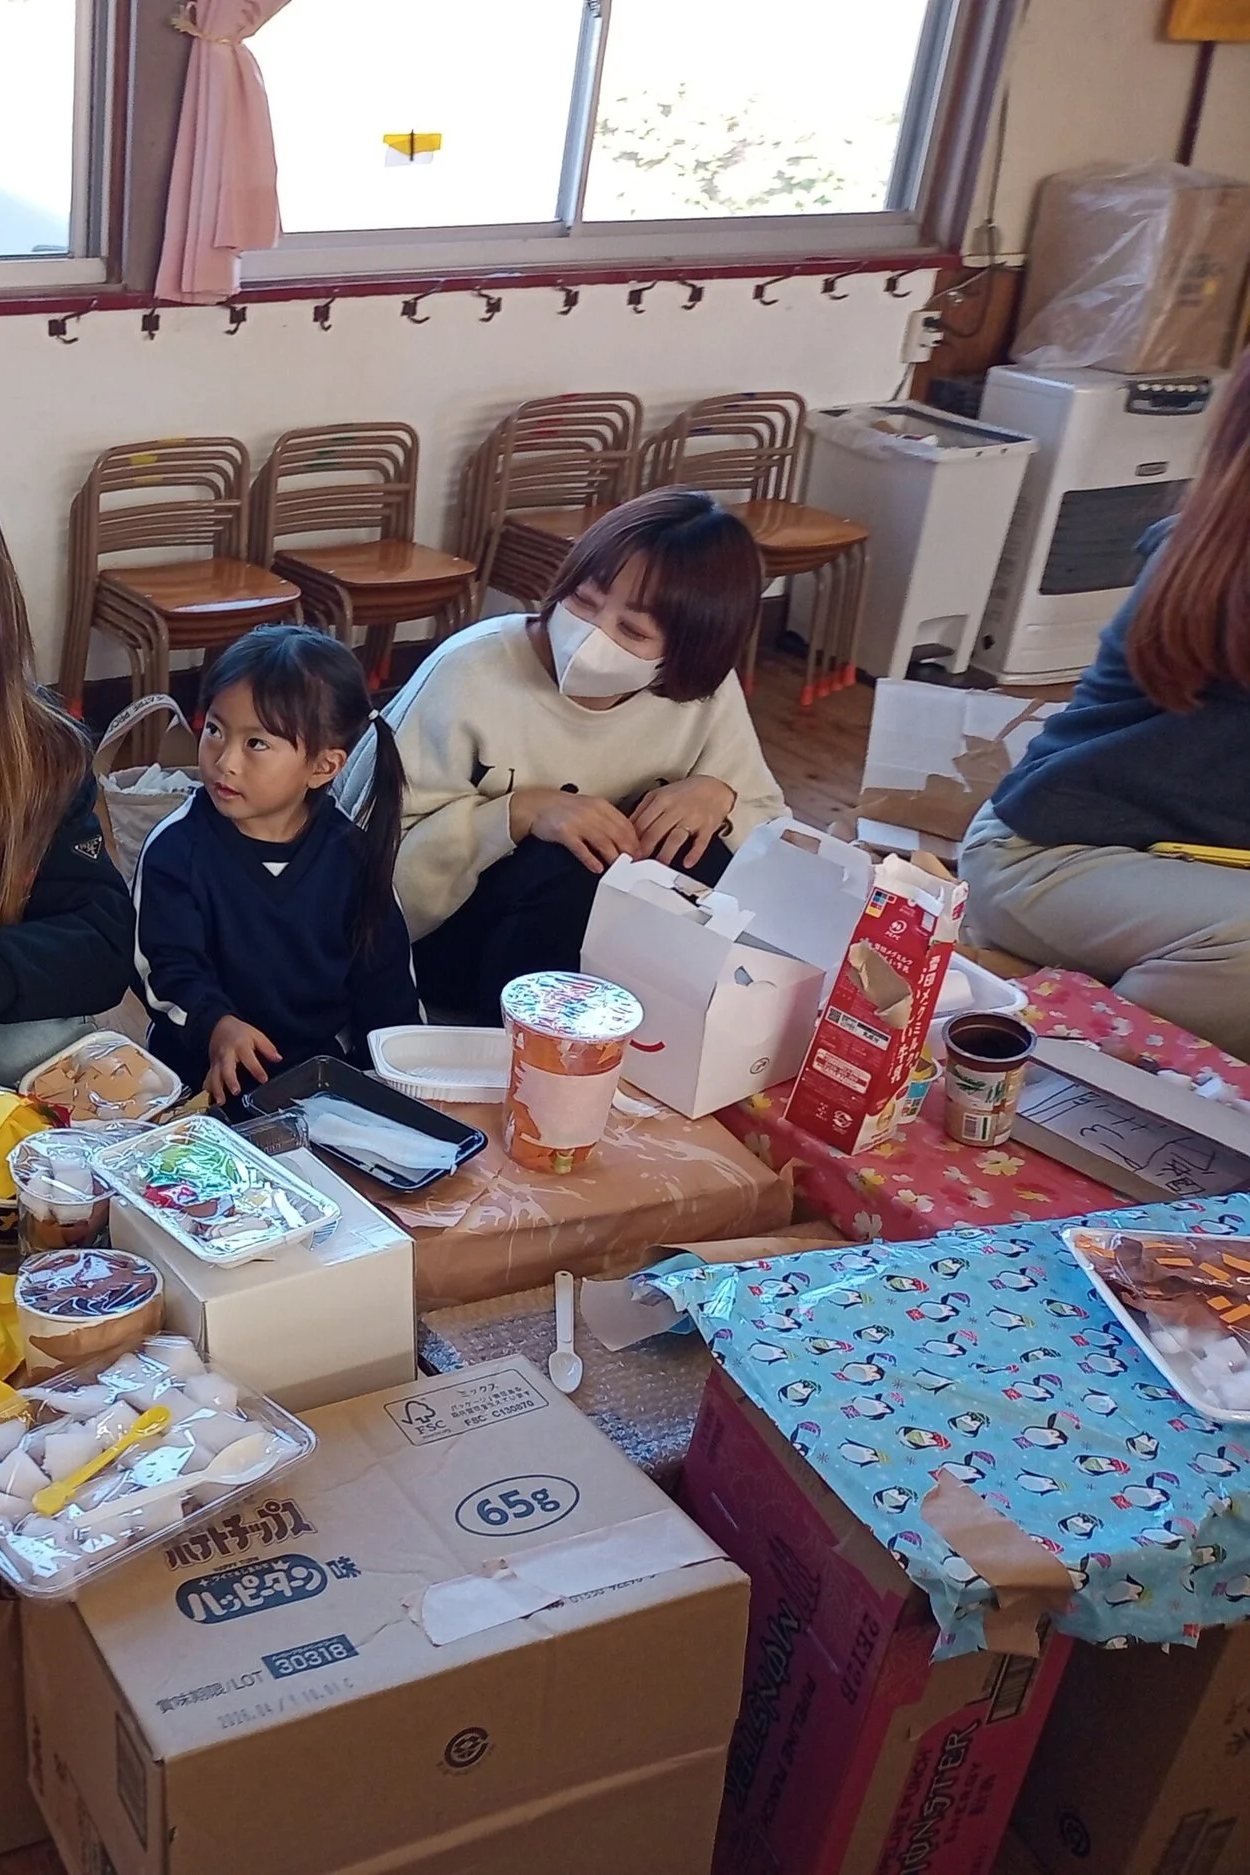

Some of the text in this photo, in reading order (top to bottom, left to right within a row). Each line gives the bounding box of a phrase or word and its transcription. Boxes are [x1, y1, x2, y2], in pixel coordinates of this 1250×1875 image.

[456, 1382, 499, 1398] ミックス
[415, 1419, 447, 1436] FSC
[475, 1487, 561, 1527] 65g
[325, 1555, 362, 1580] 味
[275, 1642, 348, 1675] 30318
